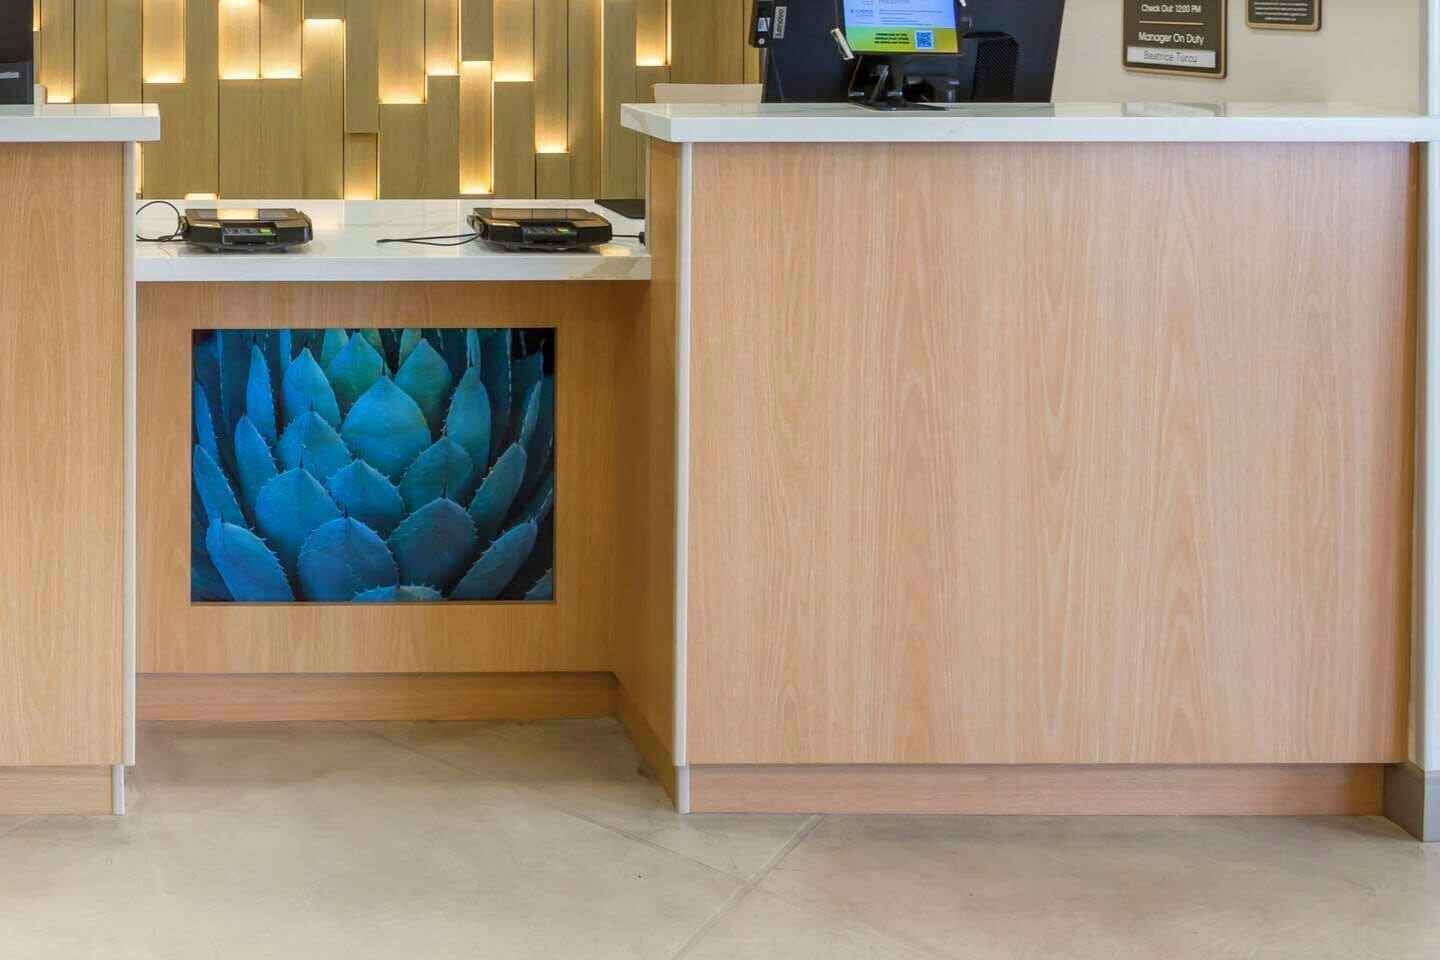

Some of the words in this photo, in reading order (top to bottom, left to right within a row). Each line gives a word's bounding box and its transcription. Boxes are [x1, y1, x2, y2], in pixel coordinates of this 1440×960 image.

[1141, 4, 1160, 13] Check
[1191, 4, 1202, 13] PM
[1138, 31, 1172, 45] Manager
[1173, 33, 1185, 43] On
[1186, 33, 1205, 47] Duty
